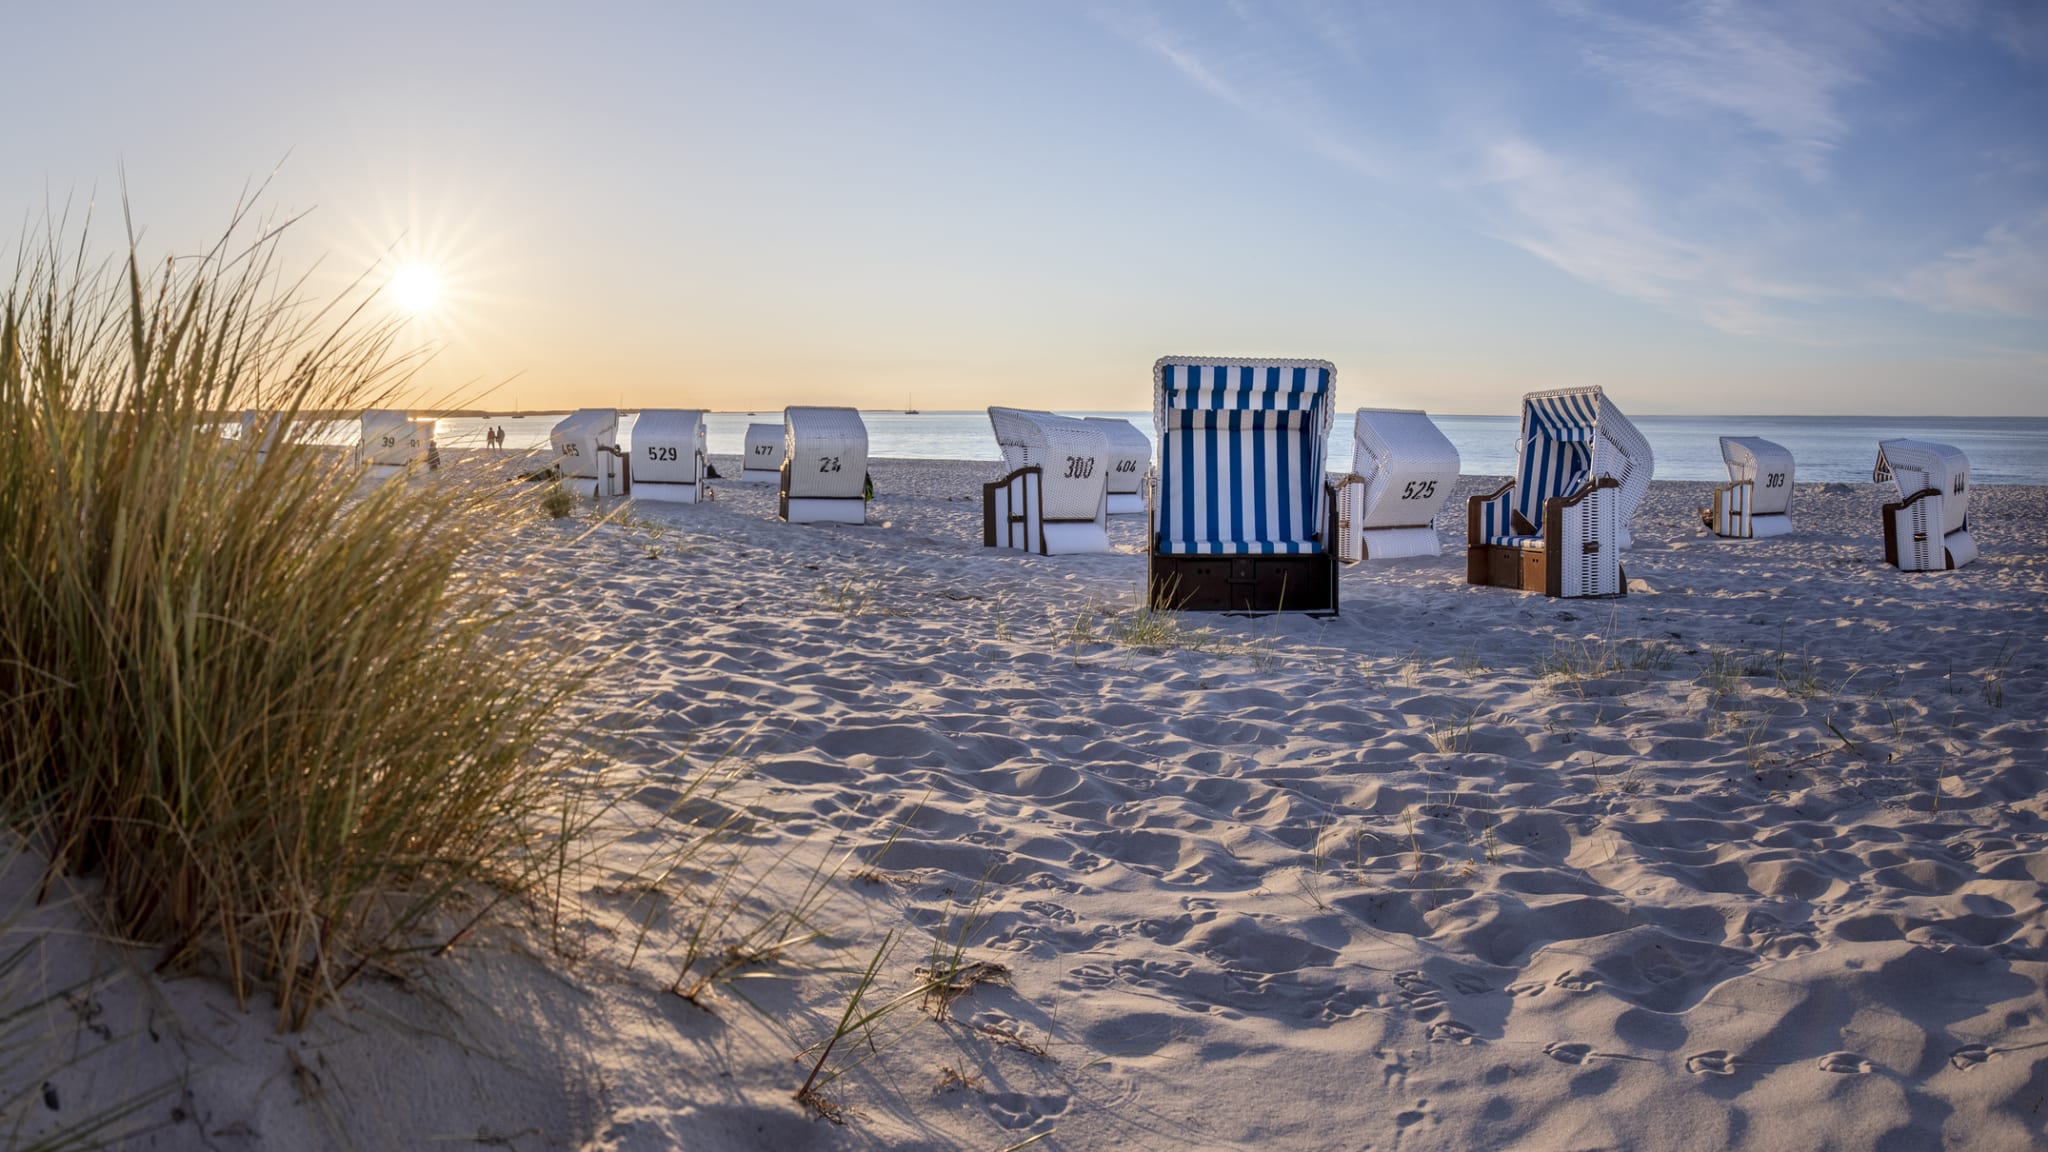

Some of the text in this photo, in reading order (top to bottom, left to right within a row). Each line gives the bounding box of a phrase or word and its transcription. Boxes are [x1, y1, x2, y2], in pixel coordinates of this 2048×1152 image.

[382, 436, 395, 448] 39
[648, 446, 678, 461] 529
[755, 445, 774, 456] 477
[1116, 460, 1137, 472] 404
[1766, 473, 1785, 488] 303
[1402, 480, 1438, 500] 525
